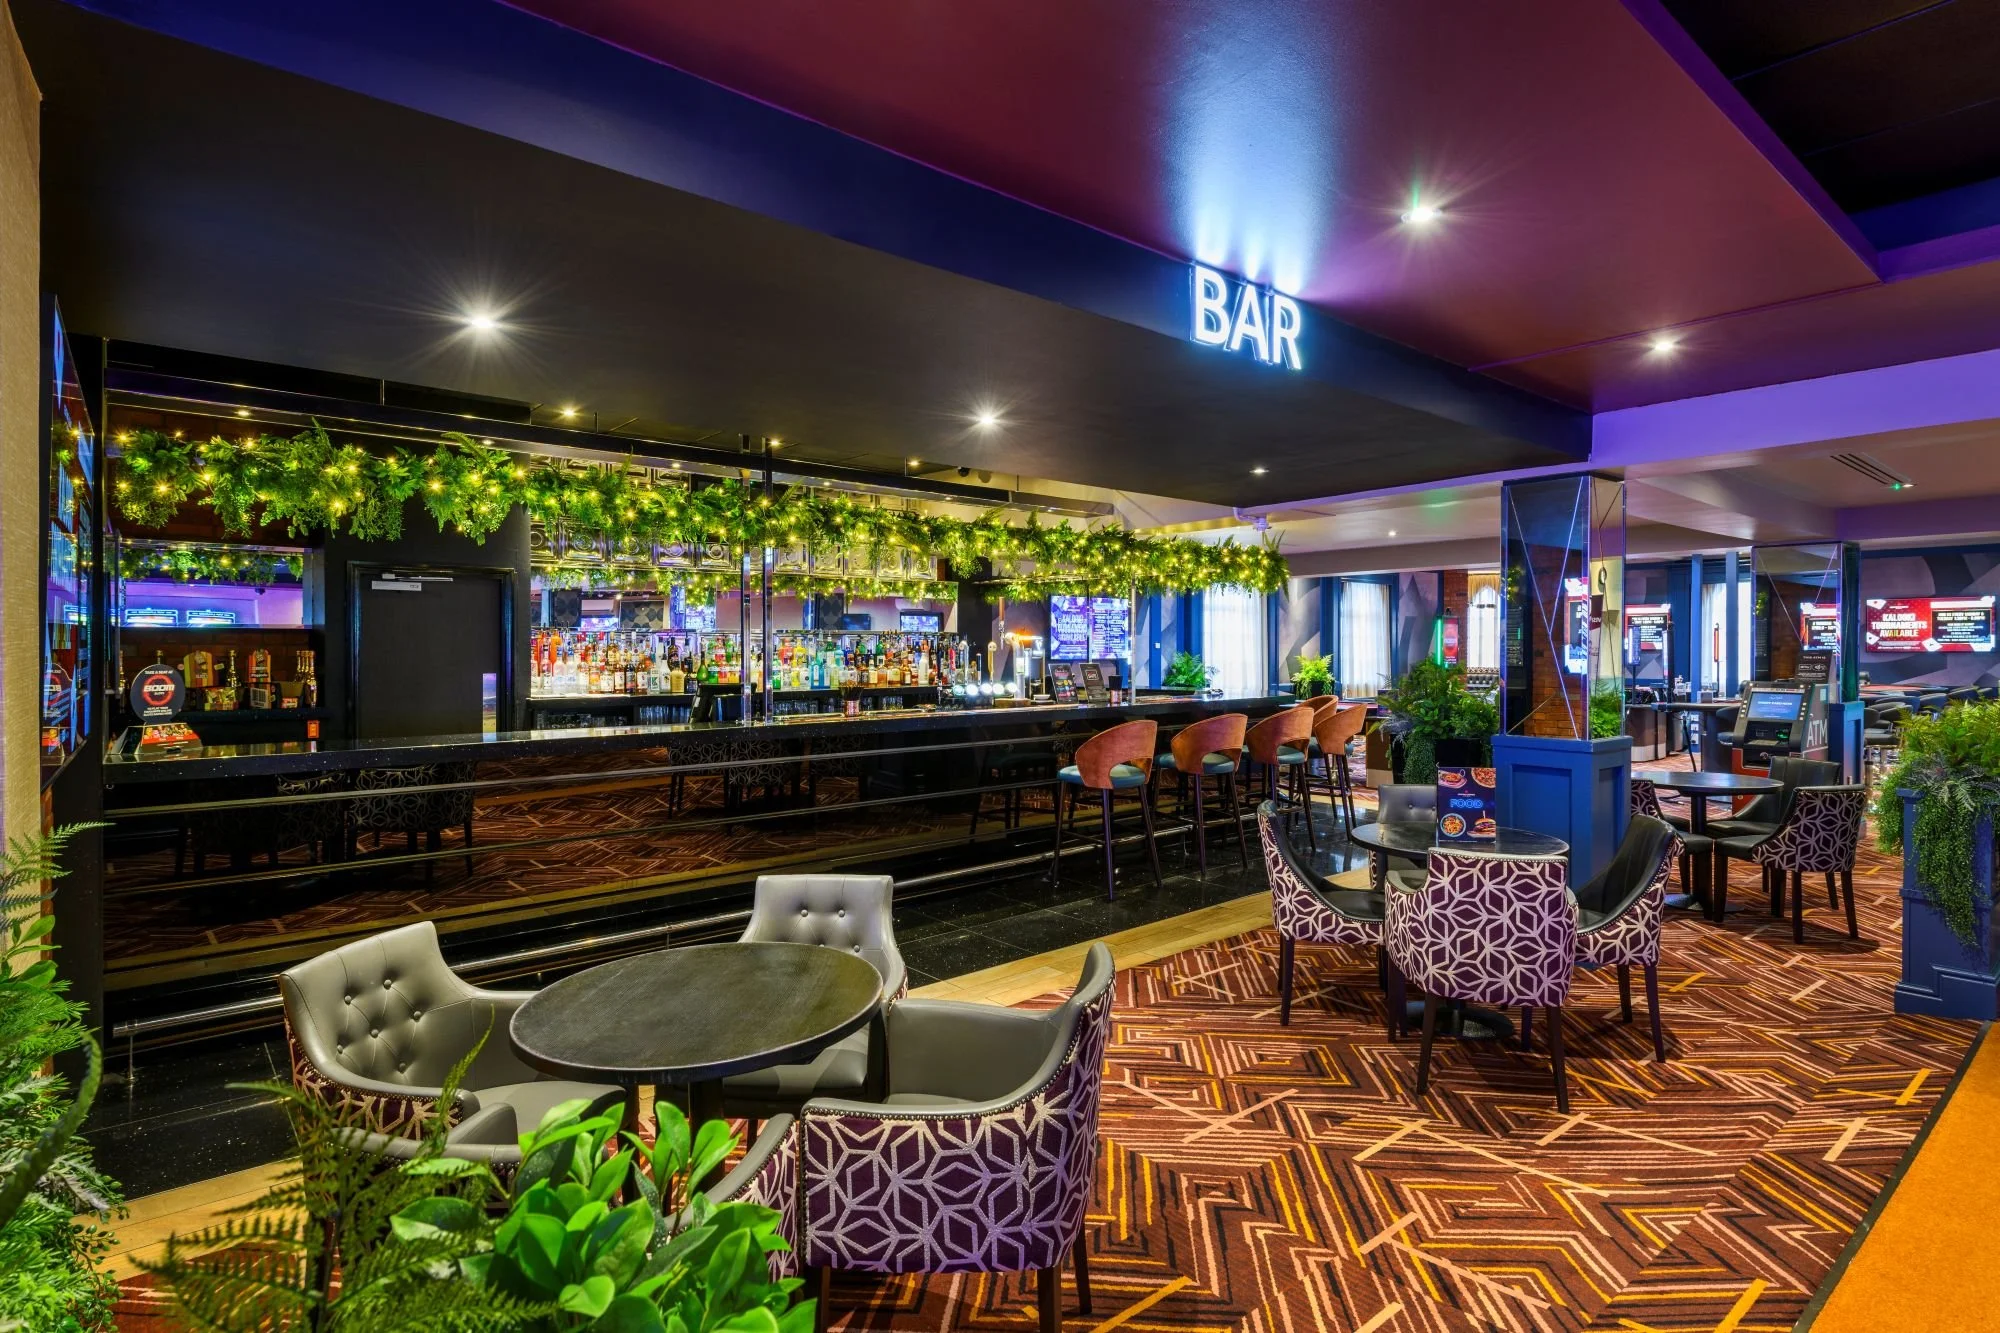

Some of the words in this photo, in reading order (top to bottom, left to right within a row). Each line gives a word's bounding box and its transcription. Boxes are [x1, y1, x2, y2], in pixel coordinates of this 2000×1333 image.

[1193, 264, 1302, 370] BAR
[1871, 621, 1928, 629] TOURNAMENTS
[1880, 629, 1919, 637] AVAILABLE
[143, 684, 176, 692] BOOM
[1807, 720, 1828, 748] ATM
[1450, 799, 1484, 809] FOOD
